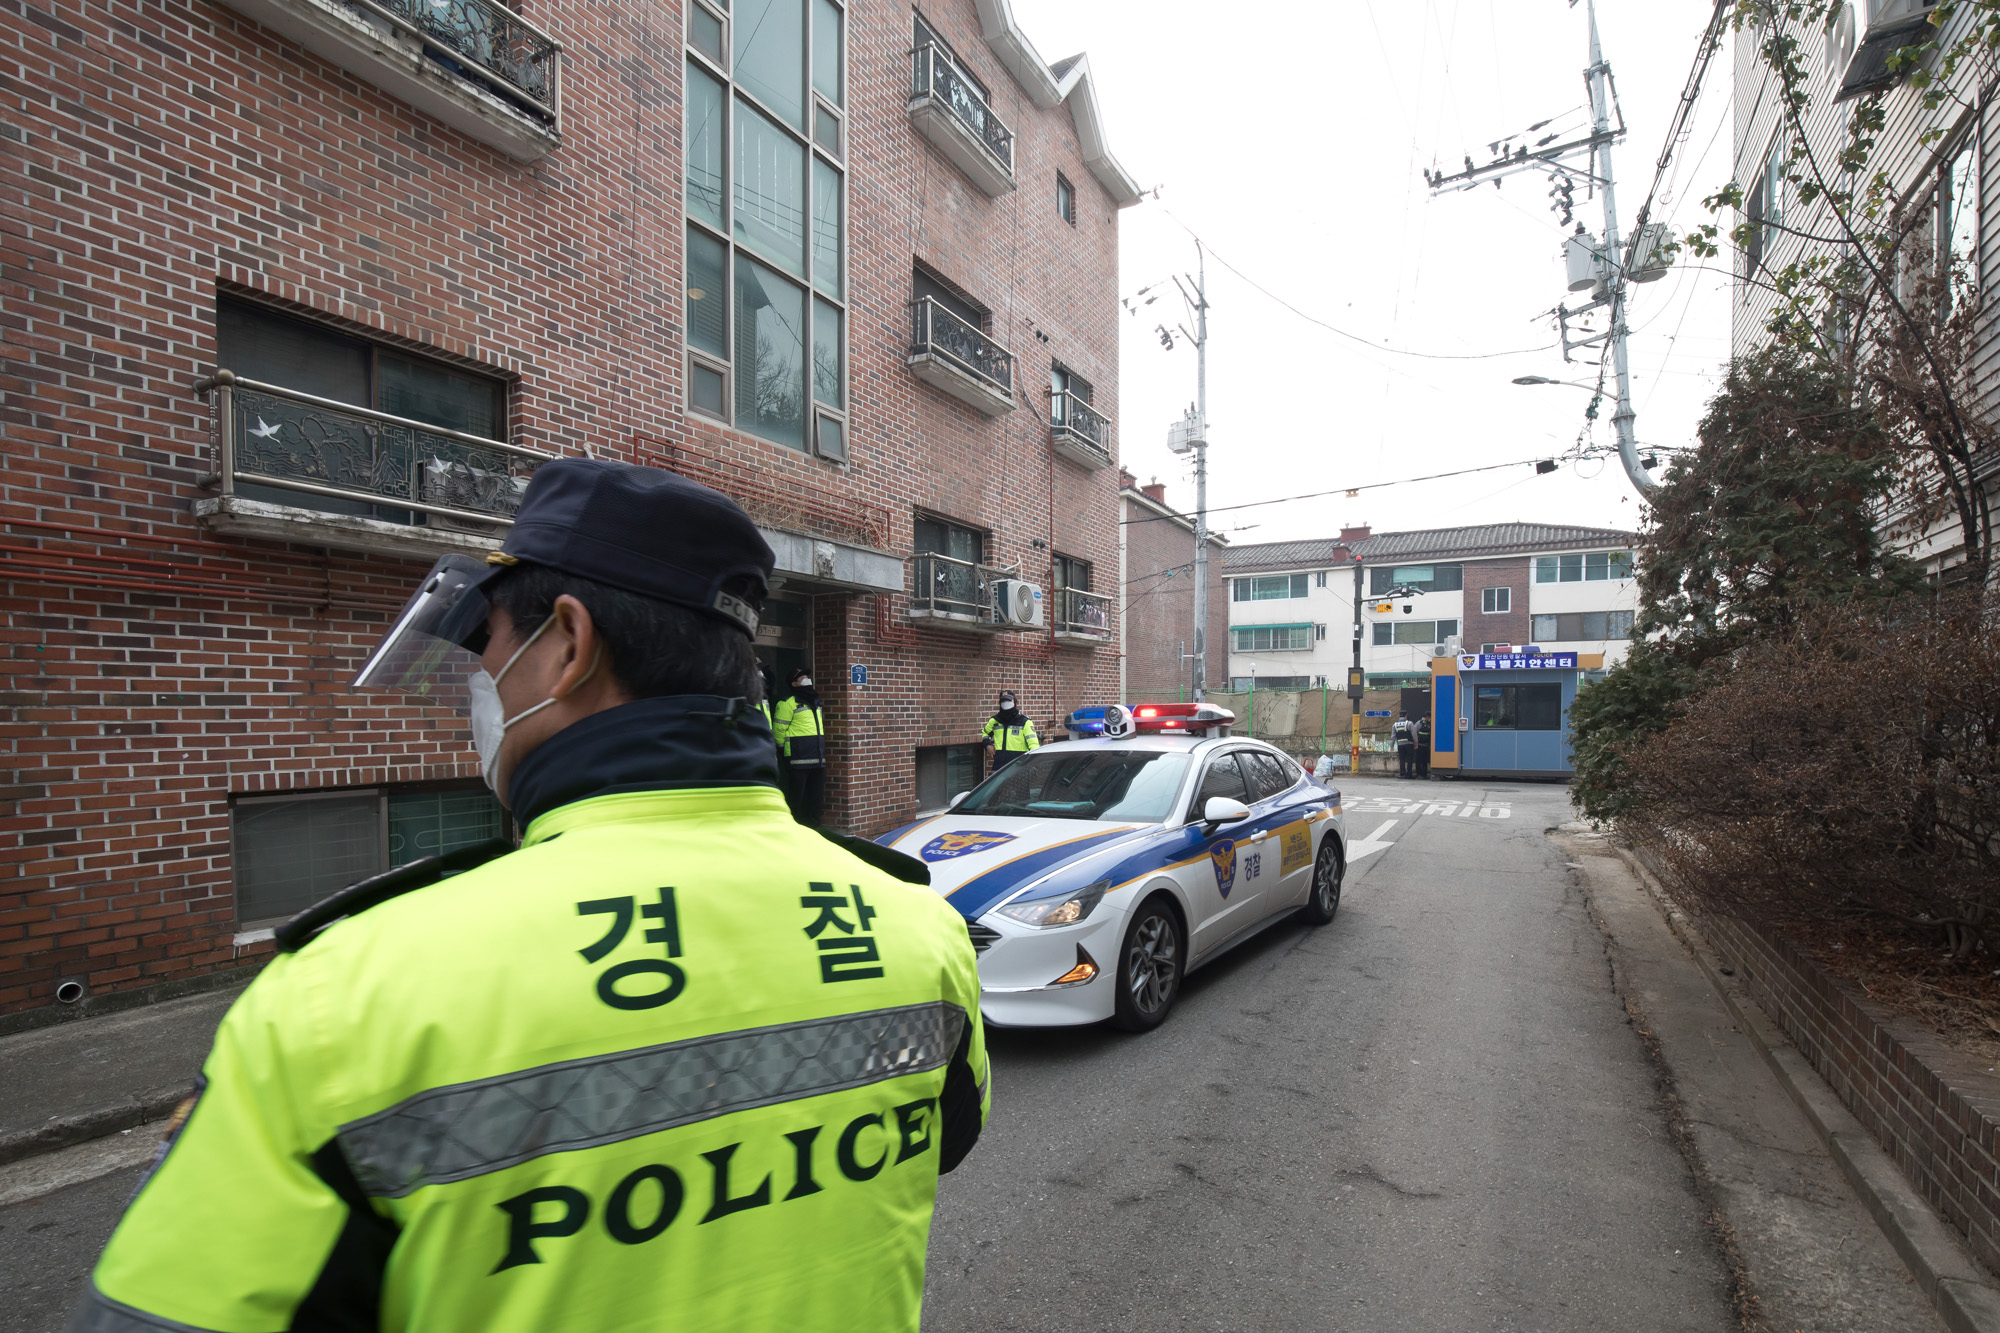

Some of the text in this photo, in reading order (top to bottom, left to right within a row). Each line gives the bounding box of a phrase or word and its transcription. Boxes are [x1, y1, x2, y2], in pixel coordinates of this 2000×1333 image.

[1484, 658, 1572, 669] 특별치안센터
[857, 674, 862, 682] 2
[1245, 852, 1261, 882] 경찰
[486, 1096, 940, 1277] POLICE
